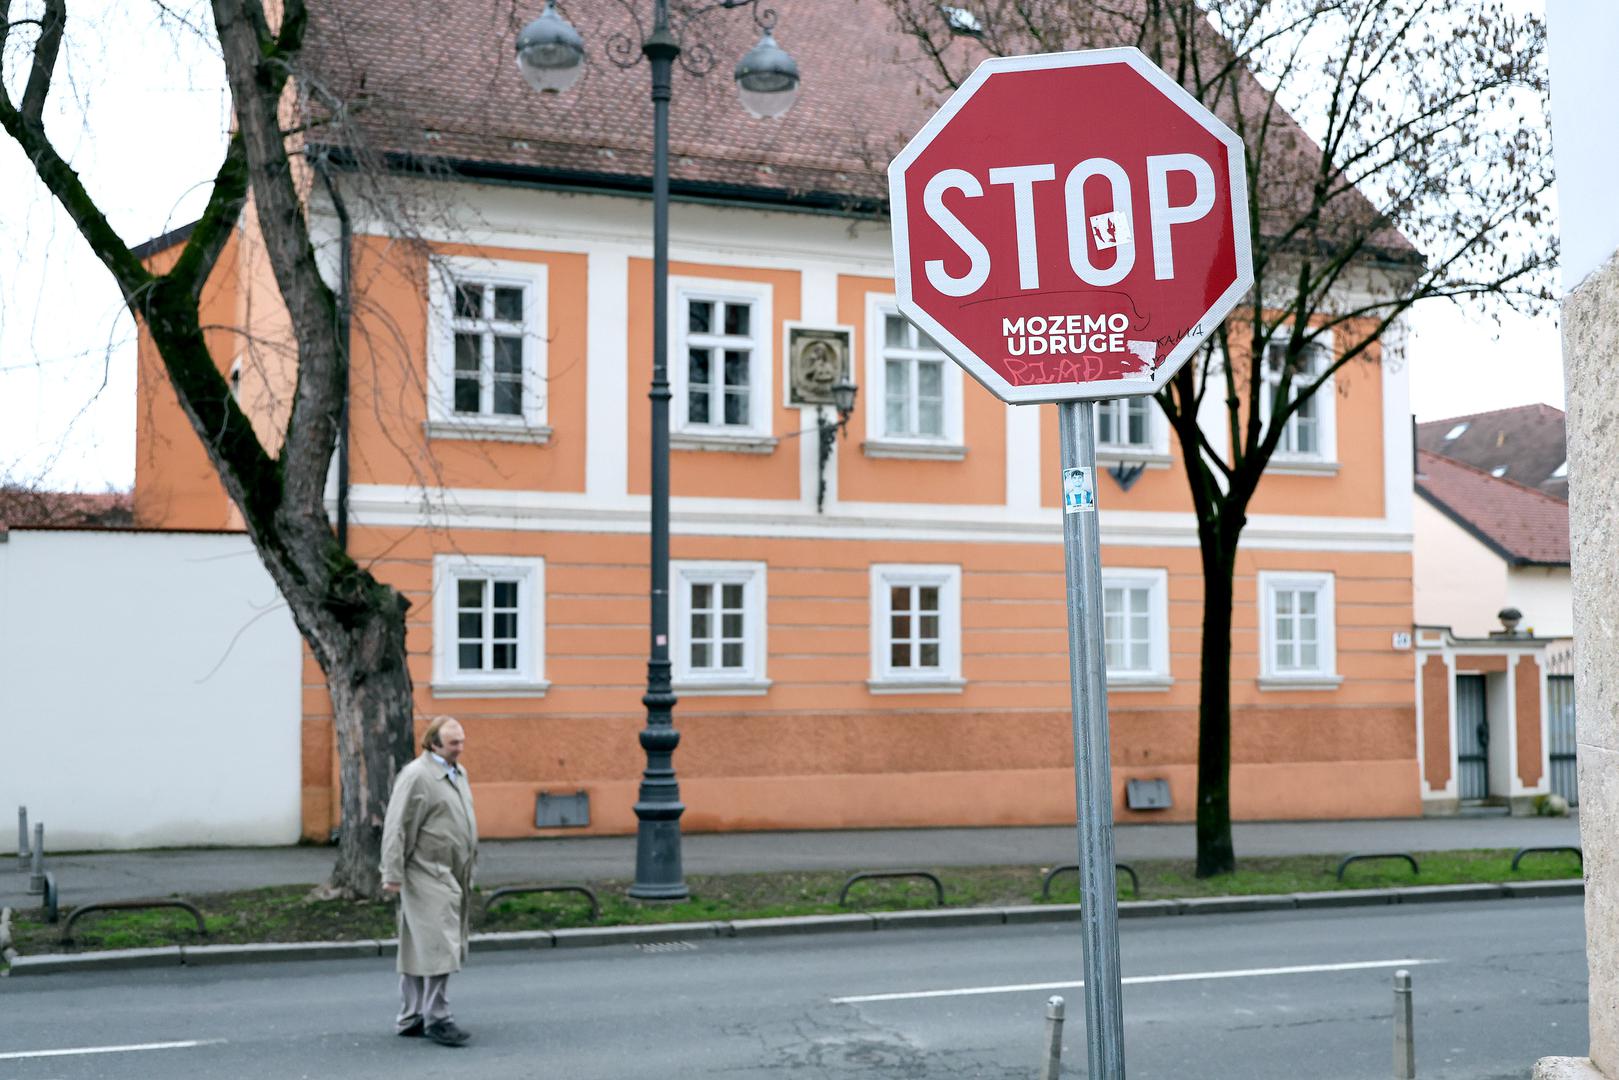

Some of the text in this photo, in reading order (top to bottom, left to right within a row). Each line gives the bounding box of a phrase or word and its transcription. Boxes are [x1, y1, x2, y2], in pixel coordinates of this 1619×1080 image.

[923, 153, 1216, 297] STOP
[1002, 313, 1129, 336] MOZEMO
[1007, 333, 1126, 356] UDRUGE
